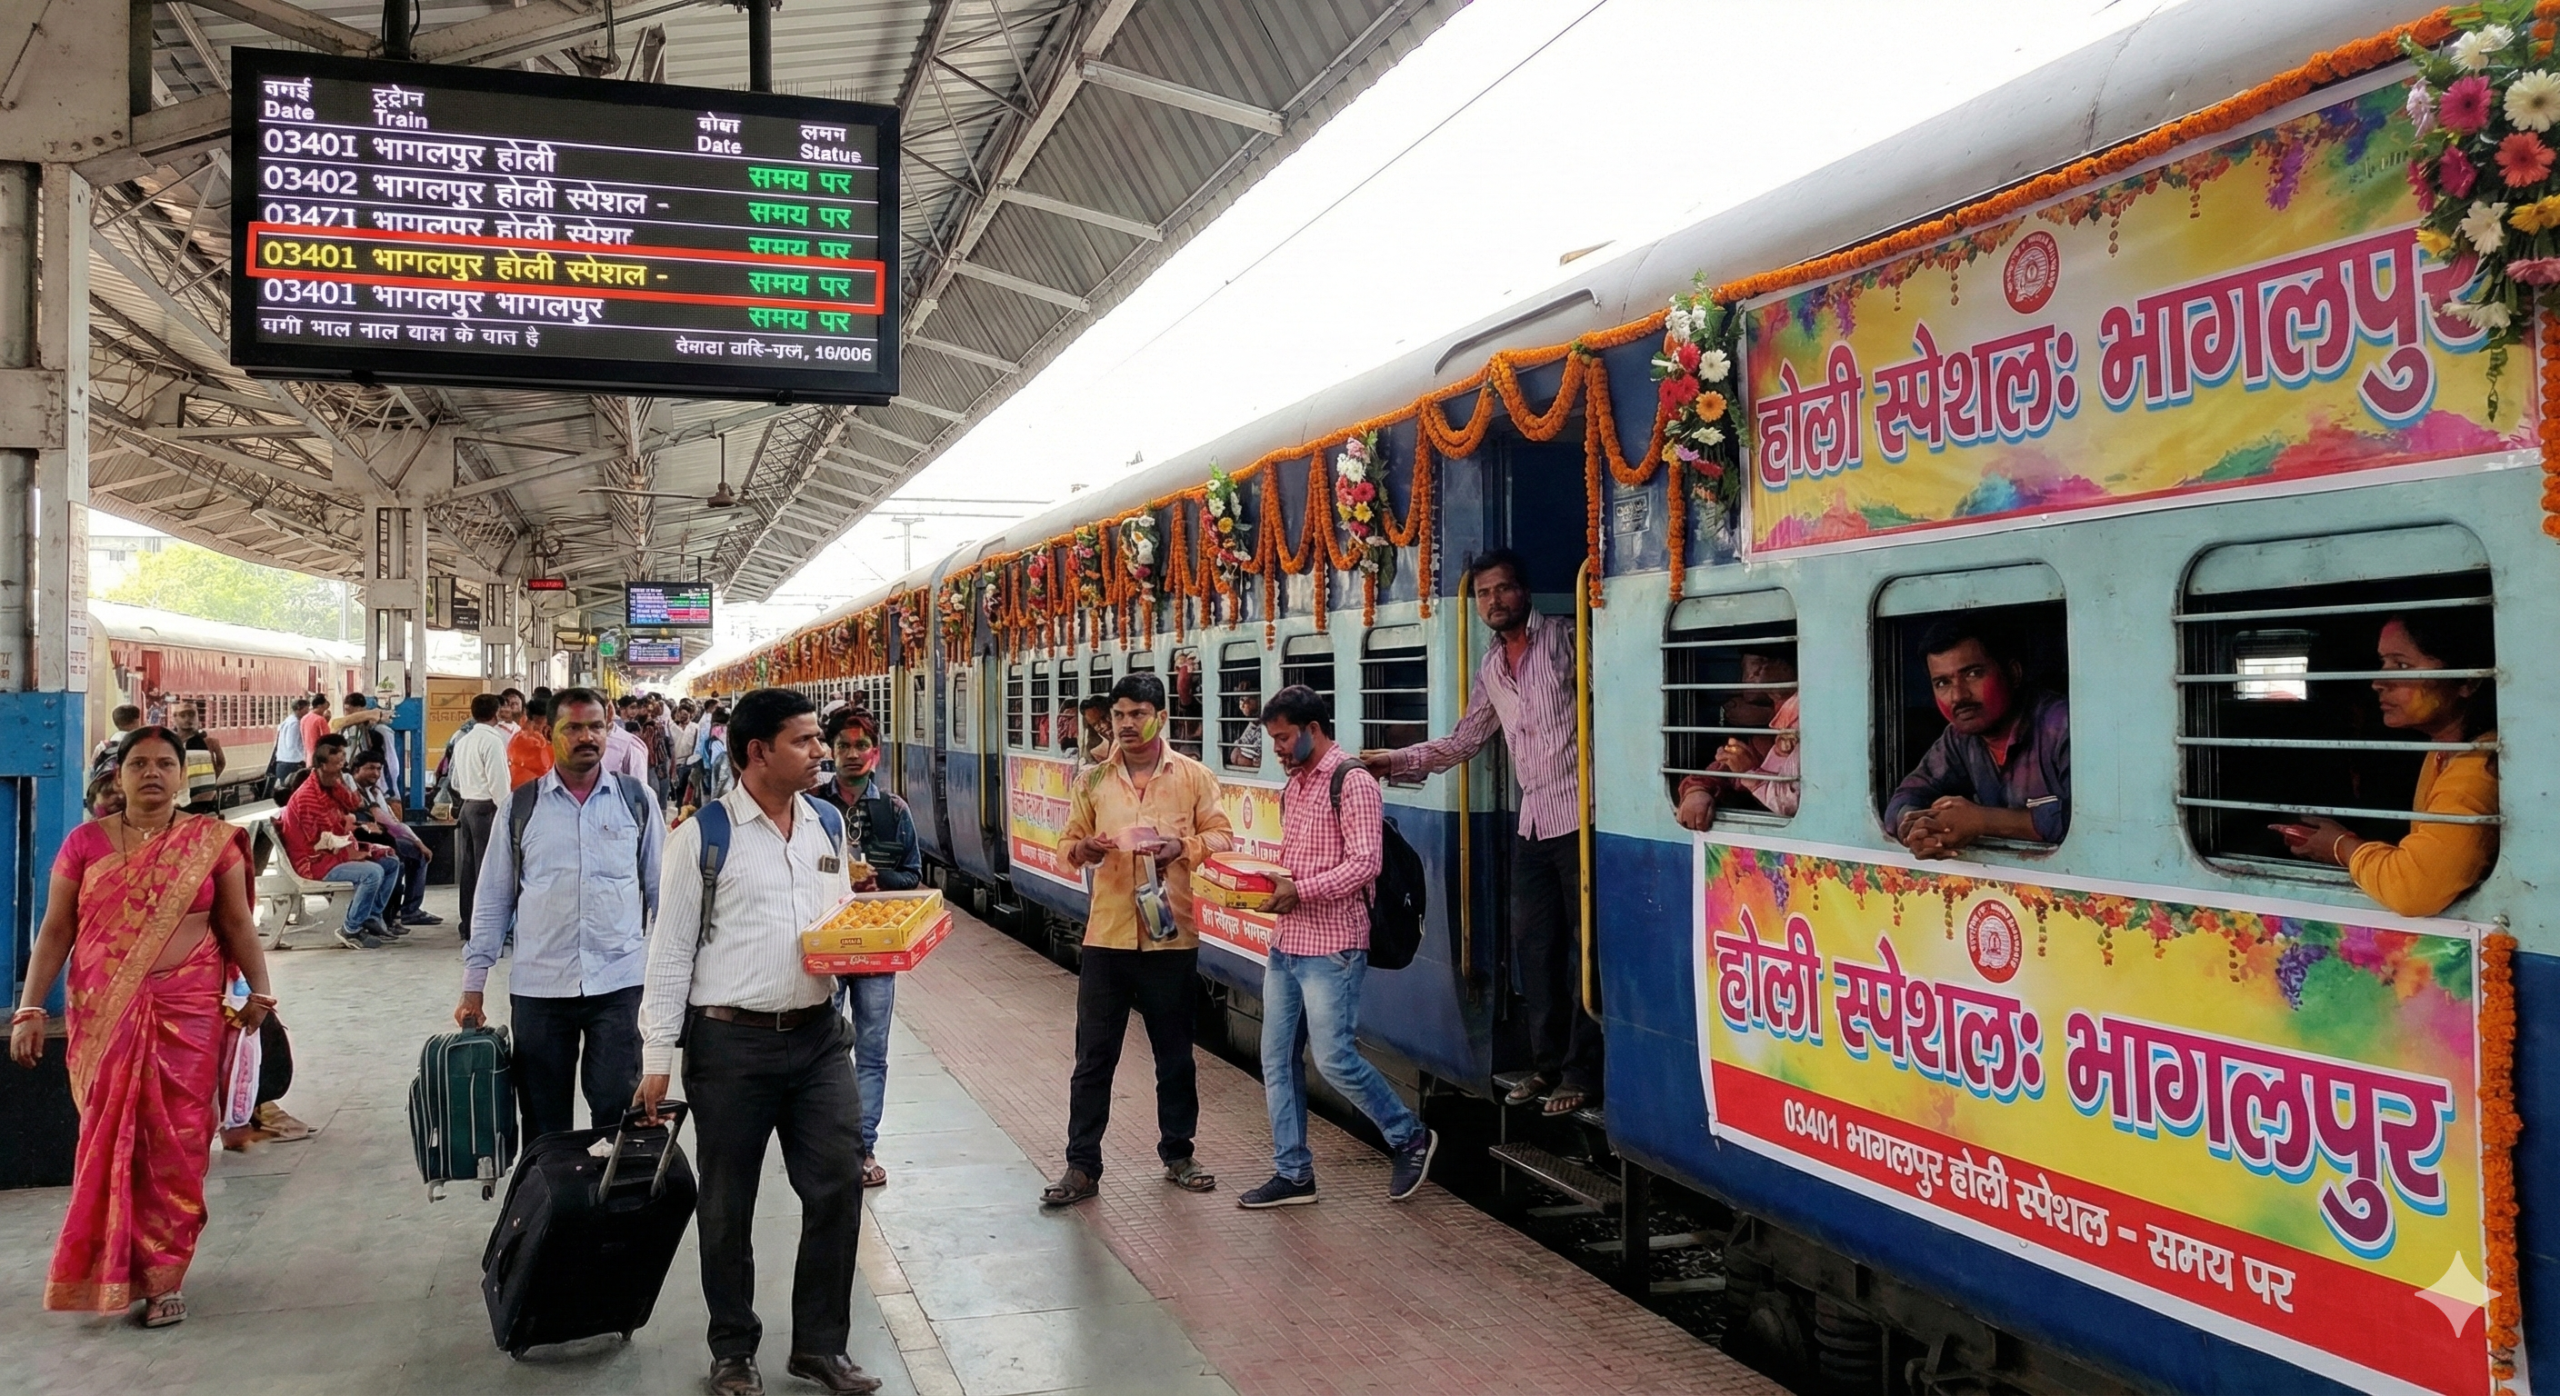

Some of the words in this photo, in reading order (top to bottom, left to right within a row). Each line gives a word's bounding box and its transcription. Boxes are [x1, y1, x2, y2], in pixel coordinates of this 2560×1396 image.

[264, 100, 315, 120] Date
[373, 108, 429, 129] Train
[264, 128, 359, 158] 03401
[372, 137, 486, 173] भागलपुर
[494, 139, 557, 173] होली
[697, 135, 743, 155] Date
[264, 165, 359, 195] 03402
[372, 174, 487, 210] भागलपुर
[494, 176, 557, 208] होली
[565, 182, 648, 214] स्पेशल
[748, 166, 810, 191] समय
[818, 172, 852, 194] पर
[264, 202, 358, 229] 03471
[748, 202, 810, 226] समय
[818, 208, 852, 229] पर
[748, 236, 810, 257] समय
[818, 242, 852, 260] पर
[263, 240, 357, 269] 03401
[372, 248, 485, 281] भागलपुर
[494, 248, 557, 280] होली
[565, 254, 648, 286] स्पेशल
[748, 272, 810, 295] समय
[818, 276, 852, 297] पर
[263, 278, 357, 306] 03401
[372, 285, 485, 319] भागलपुर
[495, 292, 605, 325] भागलपुर
[748, 307, 810, 330] समय
[818, 311, 852, 332] पर
[453, 322, 476, 343] के
[525, 325, 541, 348] है
[1756, 339, 1865, 488] होली
[1714, 902, 1824, 1045] होली
[2064, 1008, 2456, 1260] भागलपुर
[1783, 1098, 1840, 1151] 03401
[1845, 1120, 1944, 1199] भागलपुर
[1948, 1146, 2009, 1211] होली
[2014, 1172, 2109, 1248] स्पेशल
[2117, 1225, 2138, 1243] -
[2145, 1222, 2235, 1292] समय
[2242, 1254, 2296, 1314] पर
